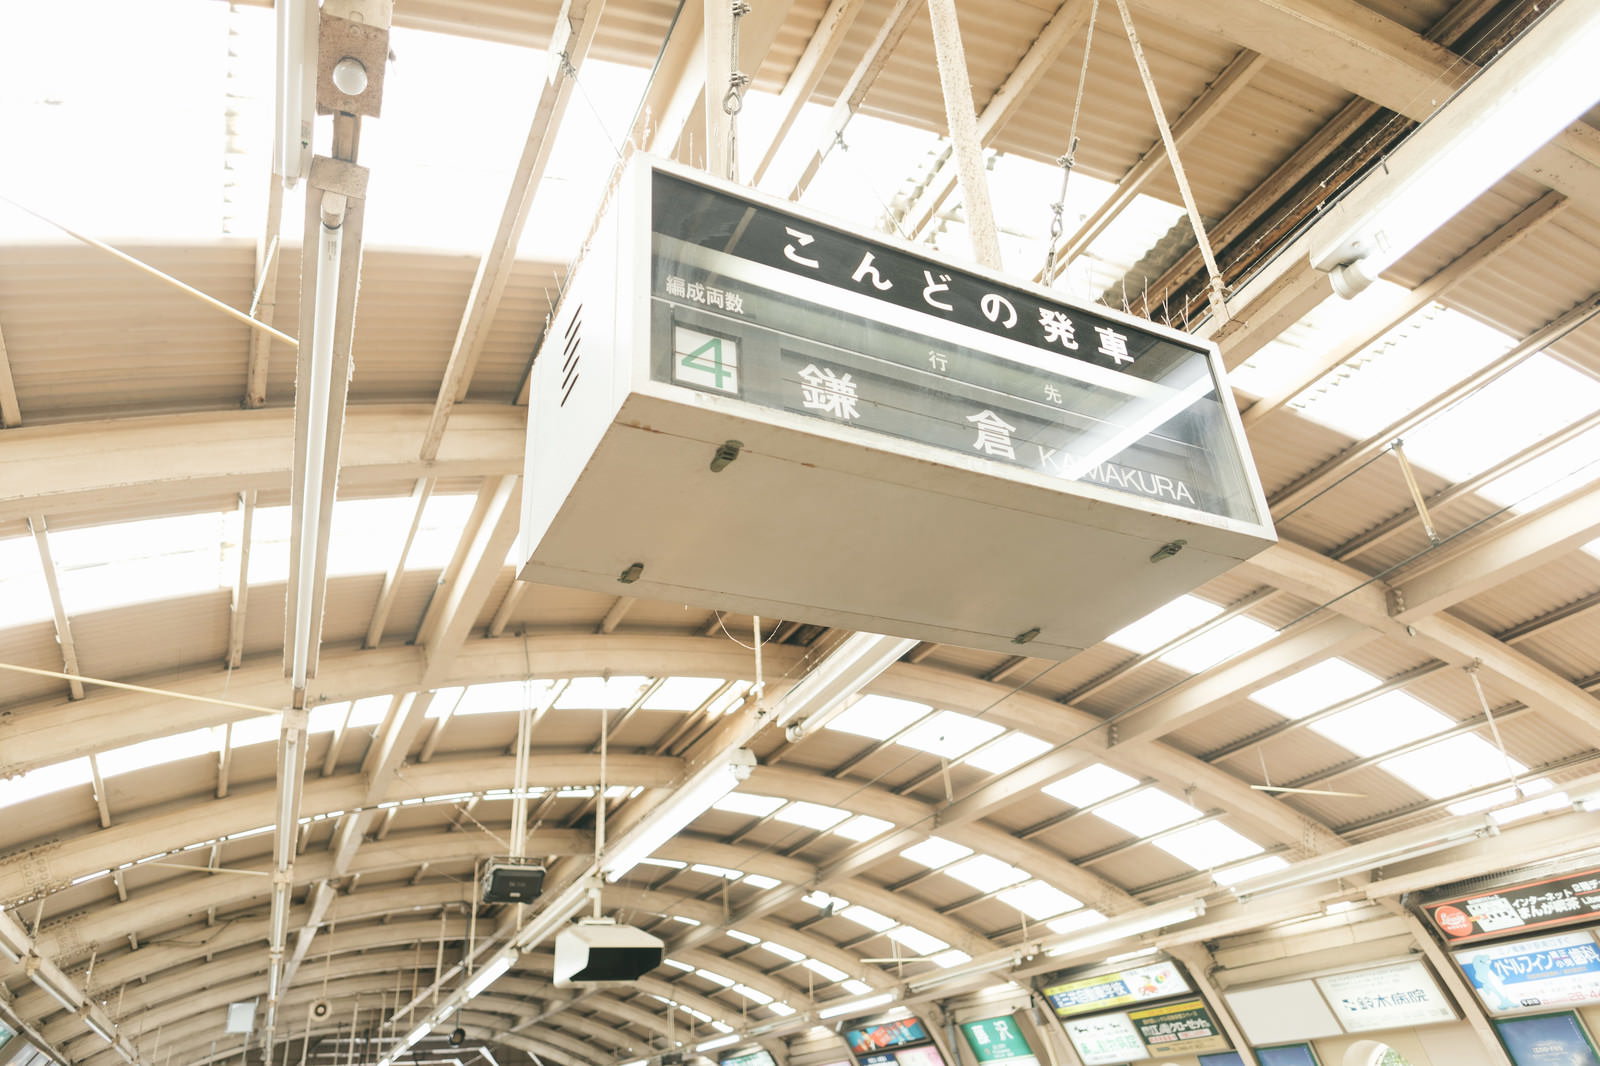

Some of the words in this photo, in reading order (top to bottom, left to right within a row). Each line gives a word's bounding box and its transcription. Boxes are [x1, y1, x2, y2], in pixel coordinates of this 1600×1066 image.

[665, 274, 745, 315] 編成両数
[783, 226, 1135, 365] こんどの発車
[681, 337, 732, 389] 4
[797, 363, 1017, 461] 鎌倉
[1037, 445, 1196, 505] KAMAKURA
